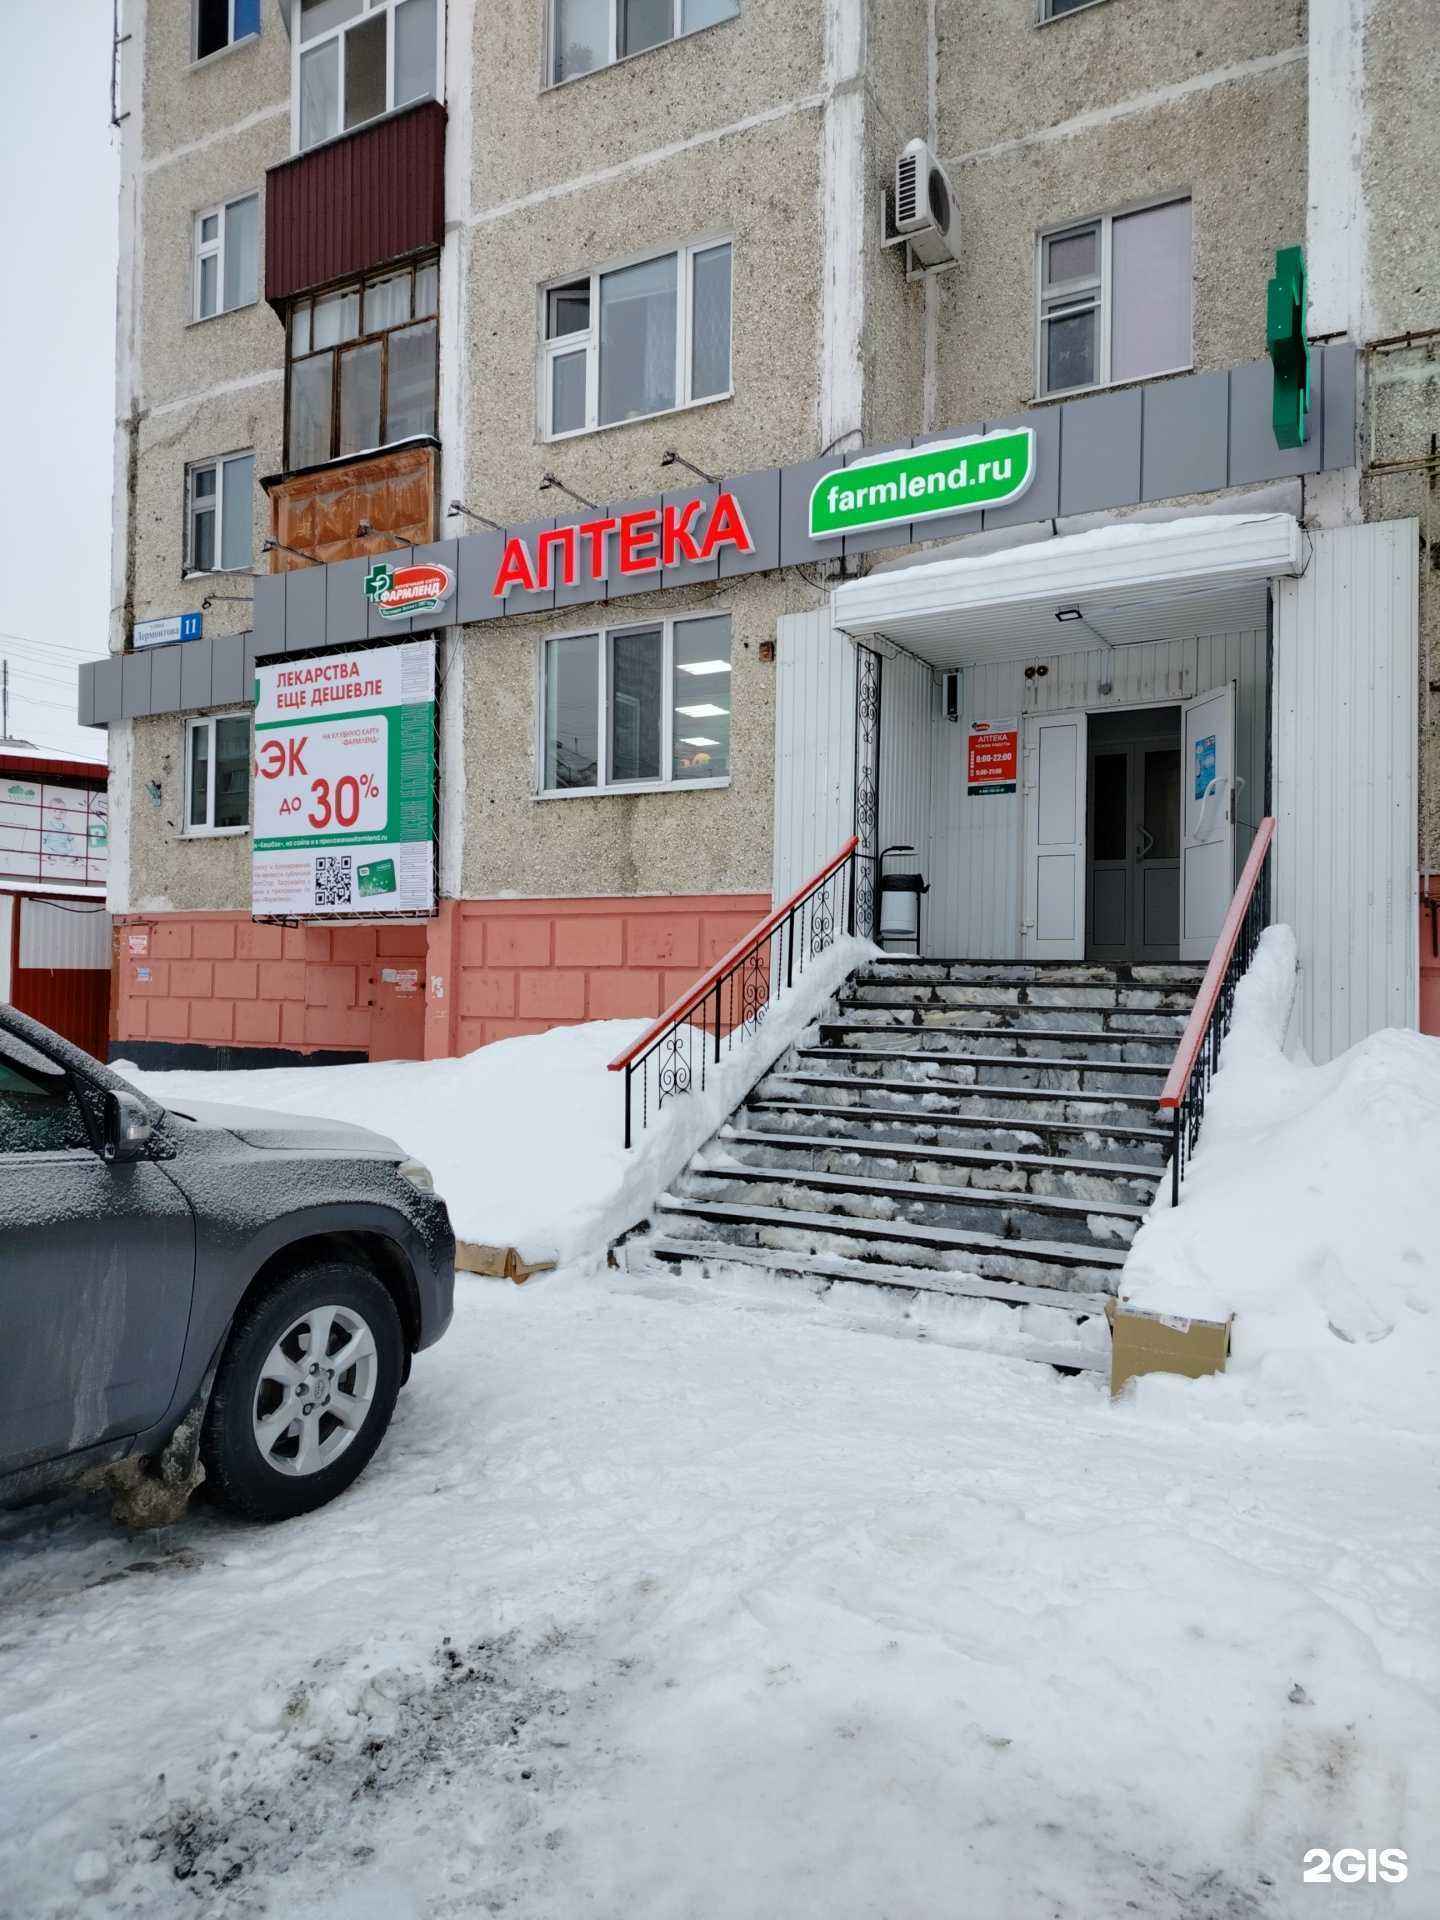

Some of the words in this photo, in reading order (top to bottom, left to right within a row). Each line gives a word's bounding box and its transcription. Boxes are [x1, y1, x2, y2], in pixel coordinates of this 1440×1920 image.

[826, 455, 1013, 514] farmlend.ru
[493, 493, 754, 598] АПТЕКА
[380, 582, 440, 603] ФАРМЛЕНД
[184, 618, 197, 635] 11
[276, 661, 360, 689] ЛЕКАРСТВА
[276, 690, 307, 709] ЕЩЕ
[310, 679, 383, 707] ДЕШЕВЛЕ
[977, 734, 1009, 743] АПТЕКА
[255, 736, 309, 780] ЭК
[308, 773, 380, 830] 30%
